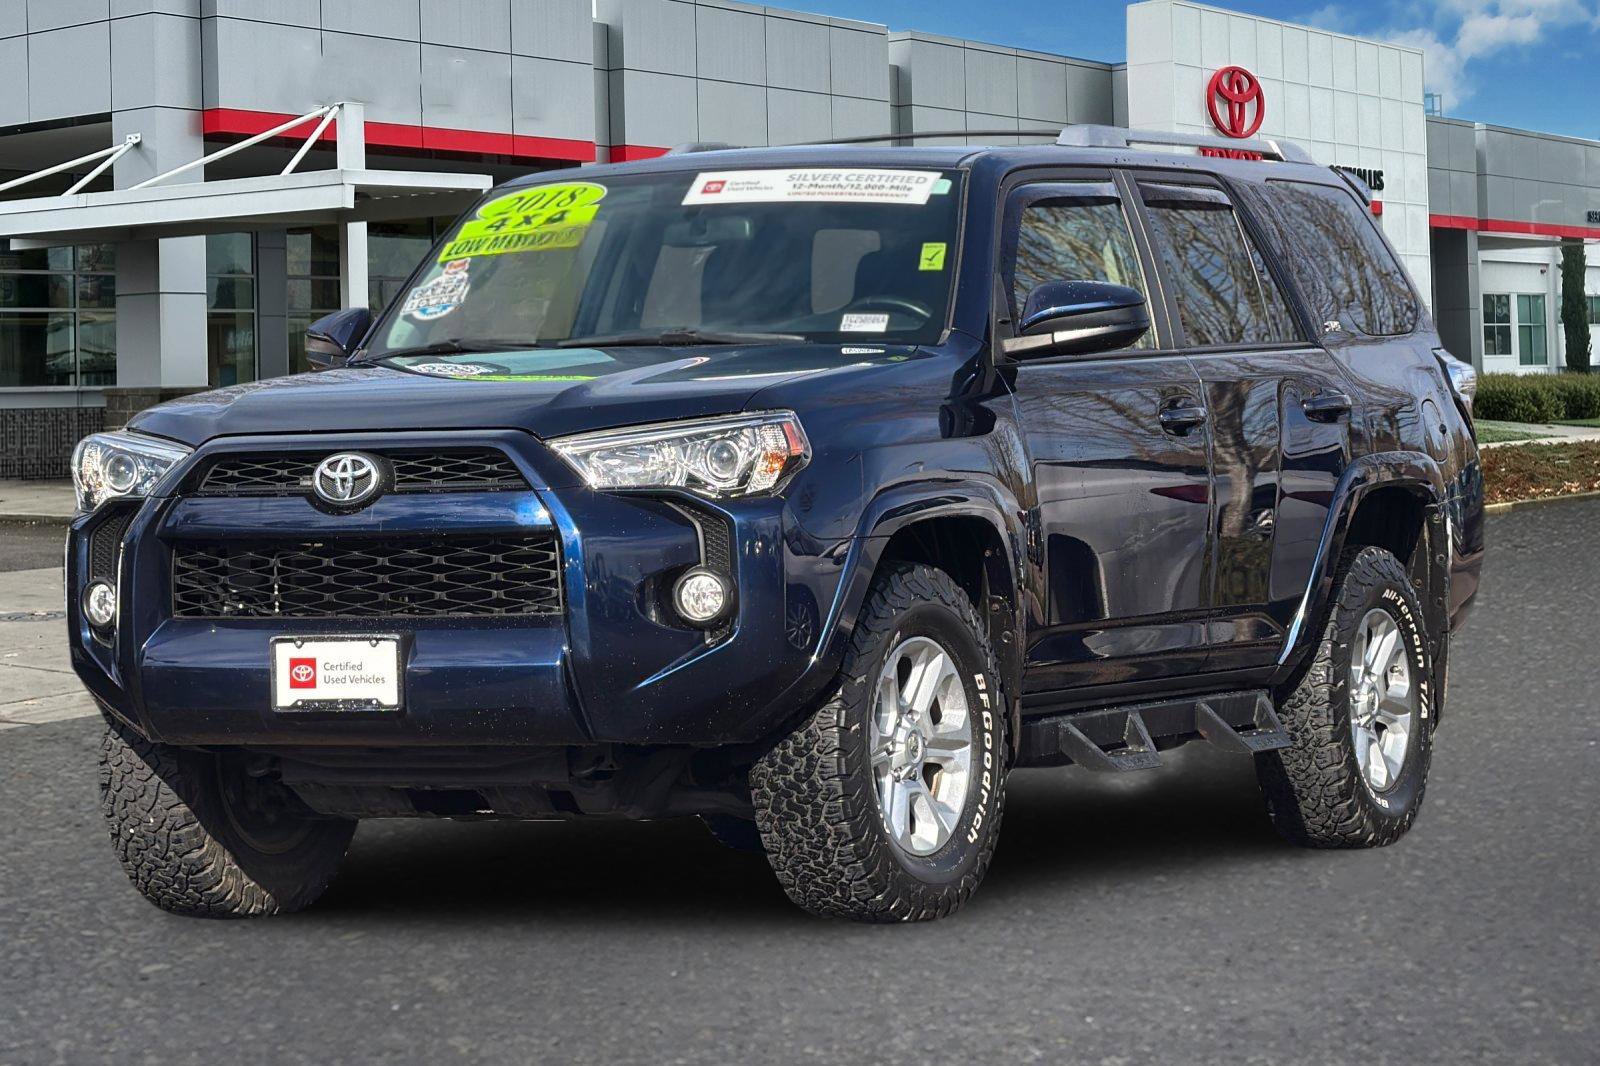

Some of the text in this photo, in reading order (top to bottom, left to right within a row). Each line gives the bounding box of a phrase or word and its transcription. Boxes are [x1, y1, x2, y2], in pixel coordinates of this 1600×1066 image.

[786, 173, 928, 184] SILVER CERTIFIED
[494, 187, 588, 217] 2018
[445, 237, 489, 257] LOW
[1382, 588, 1429, 719] All-Terrain T/A
[323, 661, 363, 671] Certified
[323, 675, 386, 684] Used Vehicles
[967, 673, 994, 844] BFGoodrich
